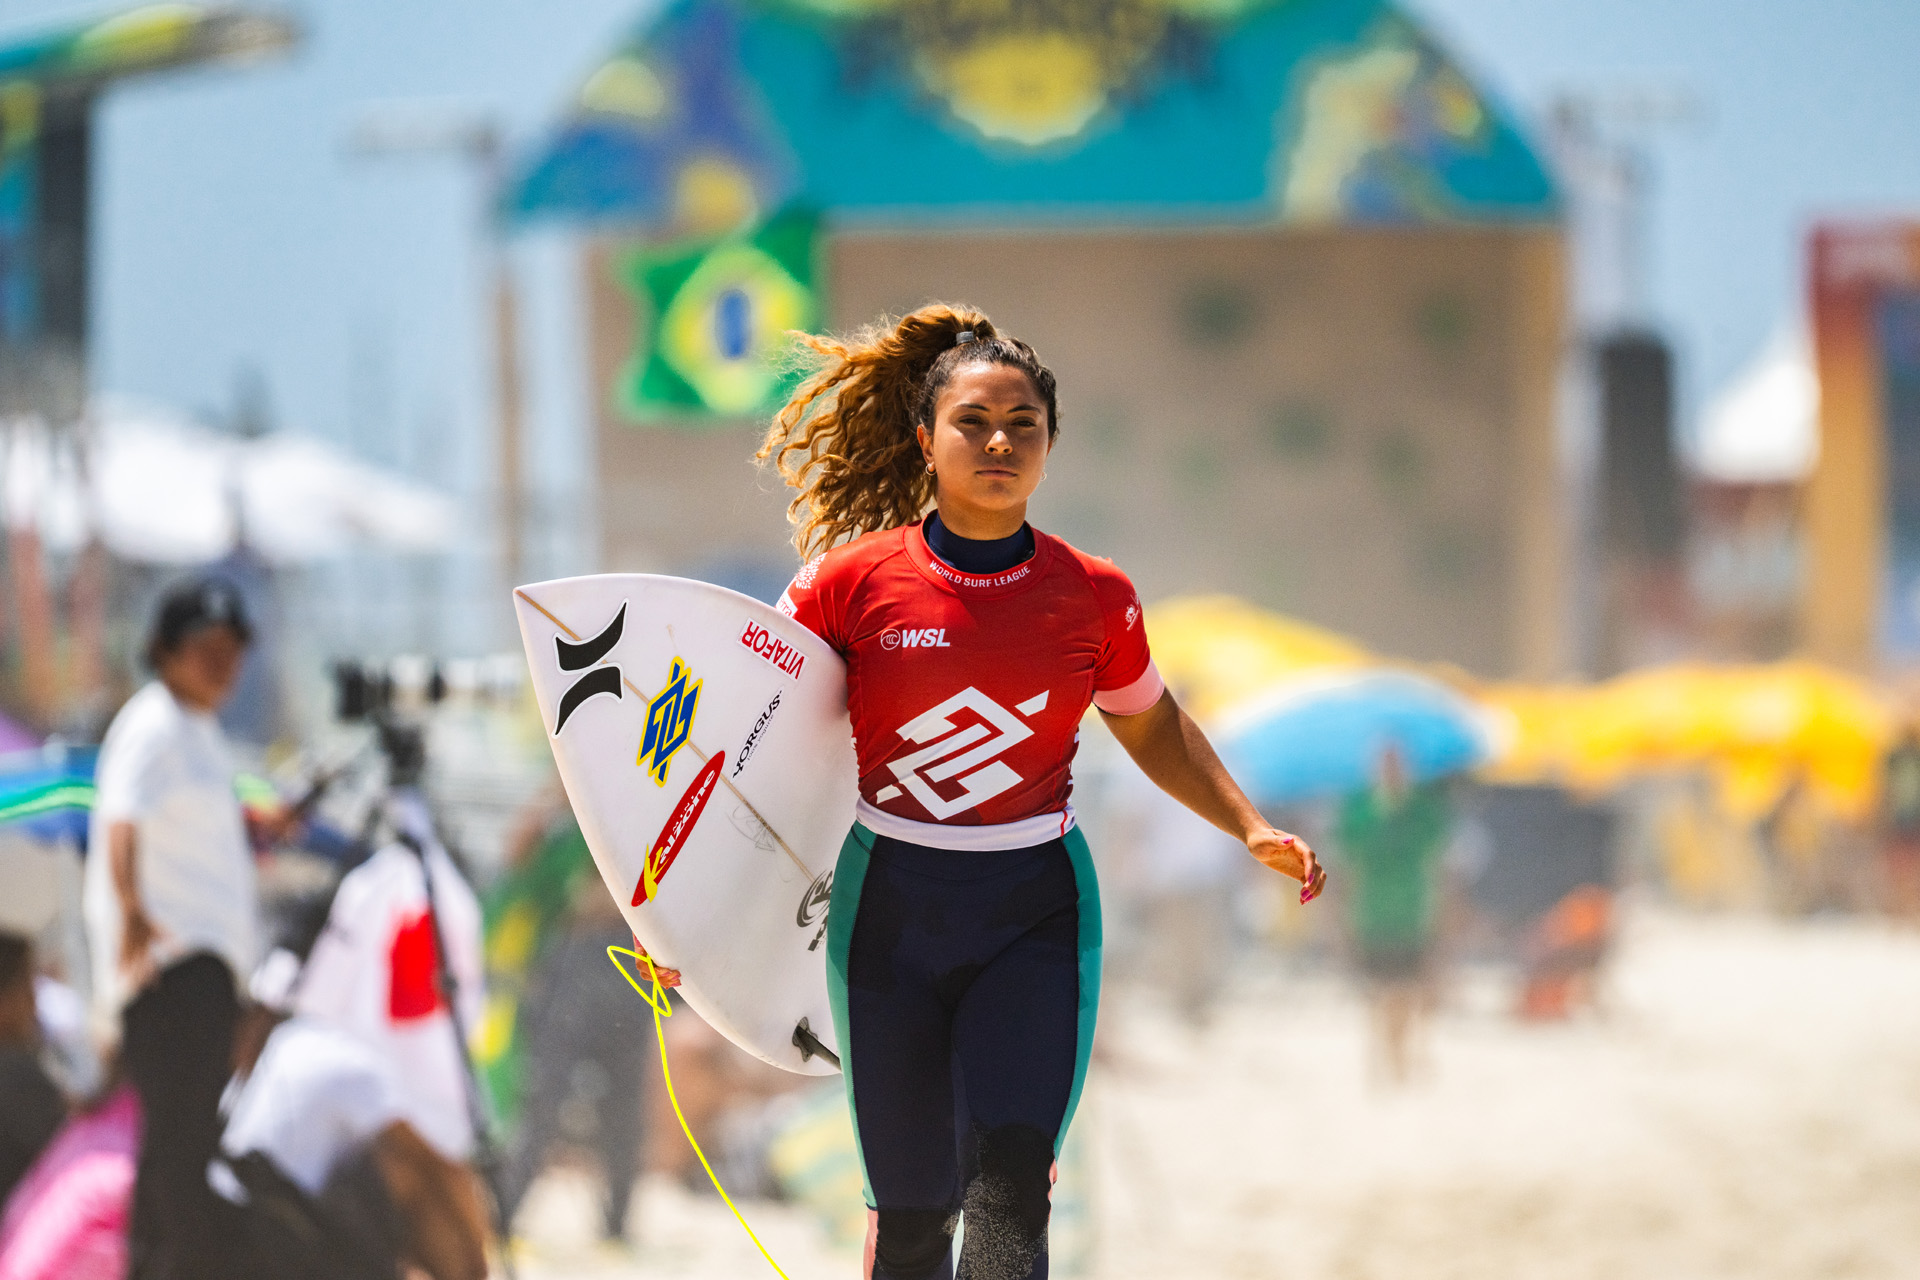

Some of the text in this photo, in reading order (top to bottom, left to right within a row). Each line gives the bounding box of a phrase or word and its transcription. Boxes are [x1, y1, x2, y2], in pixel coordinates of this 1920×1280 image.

[929, 560, 1031, 588] WORLD SURF LEAGUE
[741, 621, 805, 680] VITAFOR
[902, 628, 951, 648] WSL
[733, 693, 780, 778] YORGUS
[643, 769, 715, 903] Kalzone
[672, 795, 695, 832] MINI
